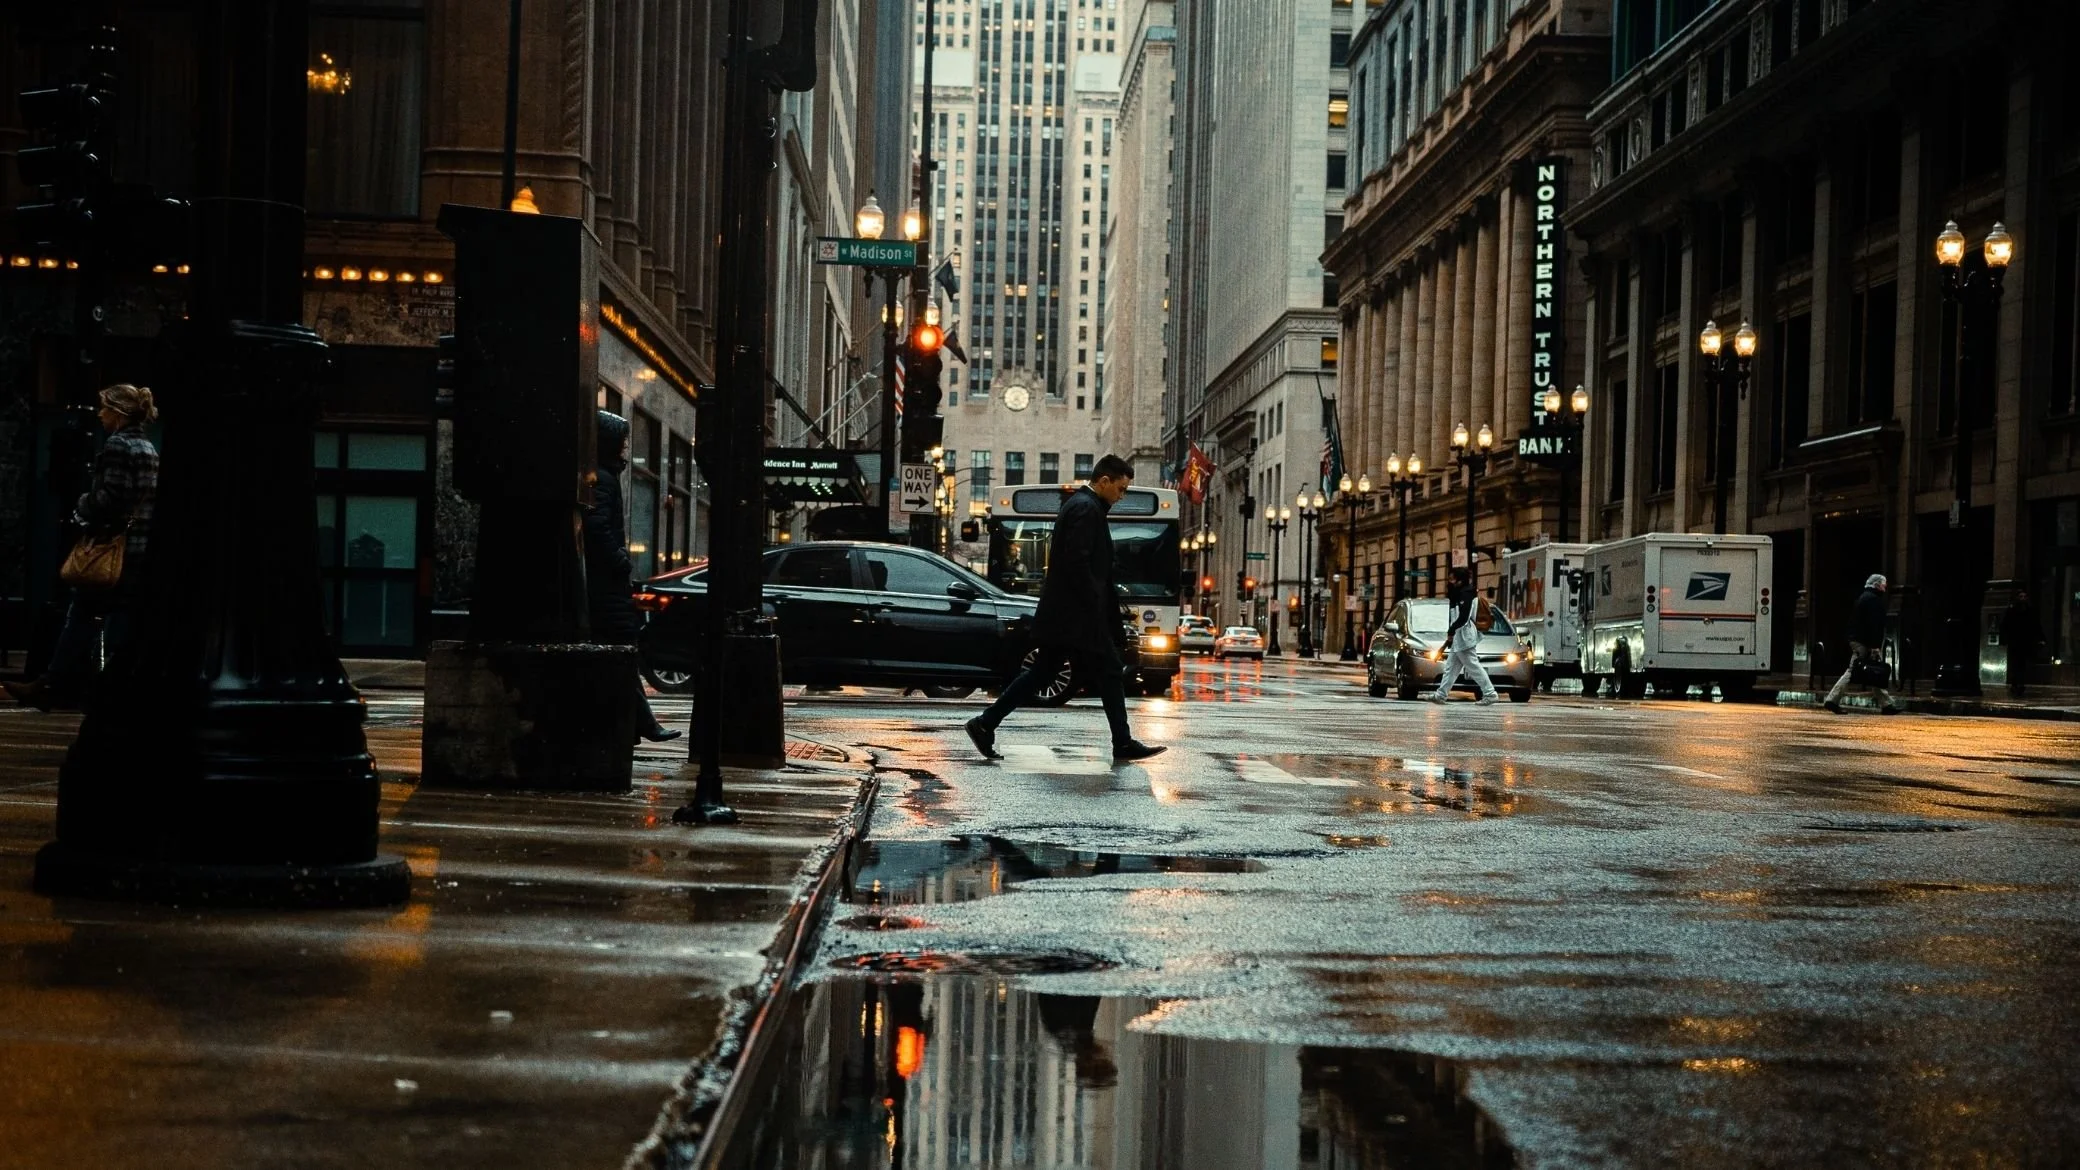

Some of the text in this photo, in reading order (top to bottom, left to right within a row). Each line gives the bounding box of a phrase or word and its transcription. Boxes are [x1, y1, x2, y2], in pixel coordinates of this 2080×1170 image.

[849, 244, 902, 260] Madison
[903, 249, 913, 258] St
[1533, 164, 1555, 426] NORTHERN TRUST
[791, 460, 807, 469] Inn
[905, 468, 932, 480] ONE
[904, 481, 932, 493] WAY
